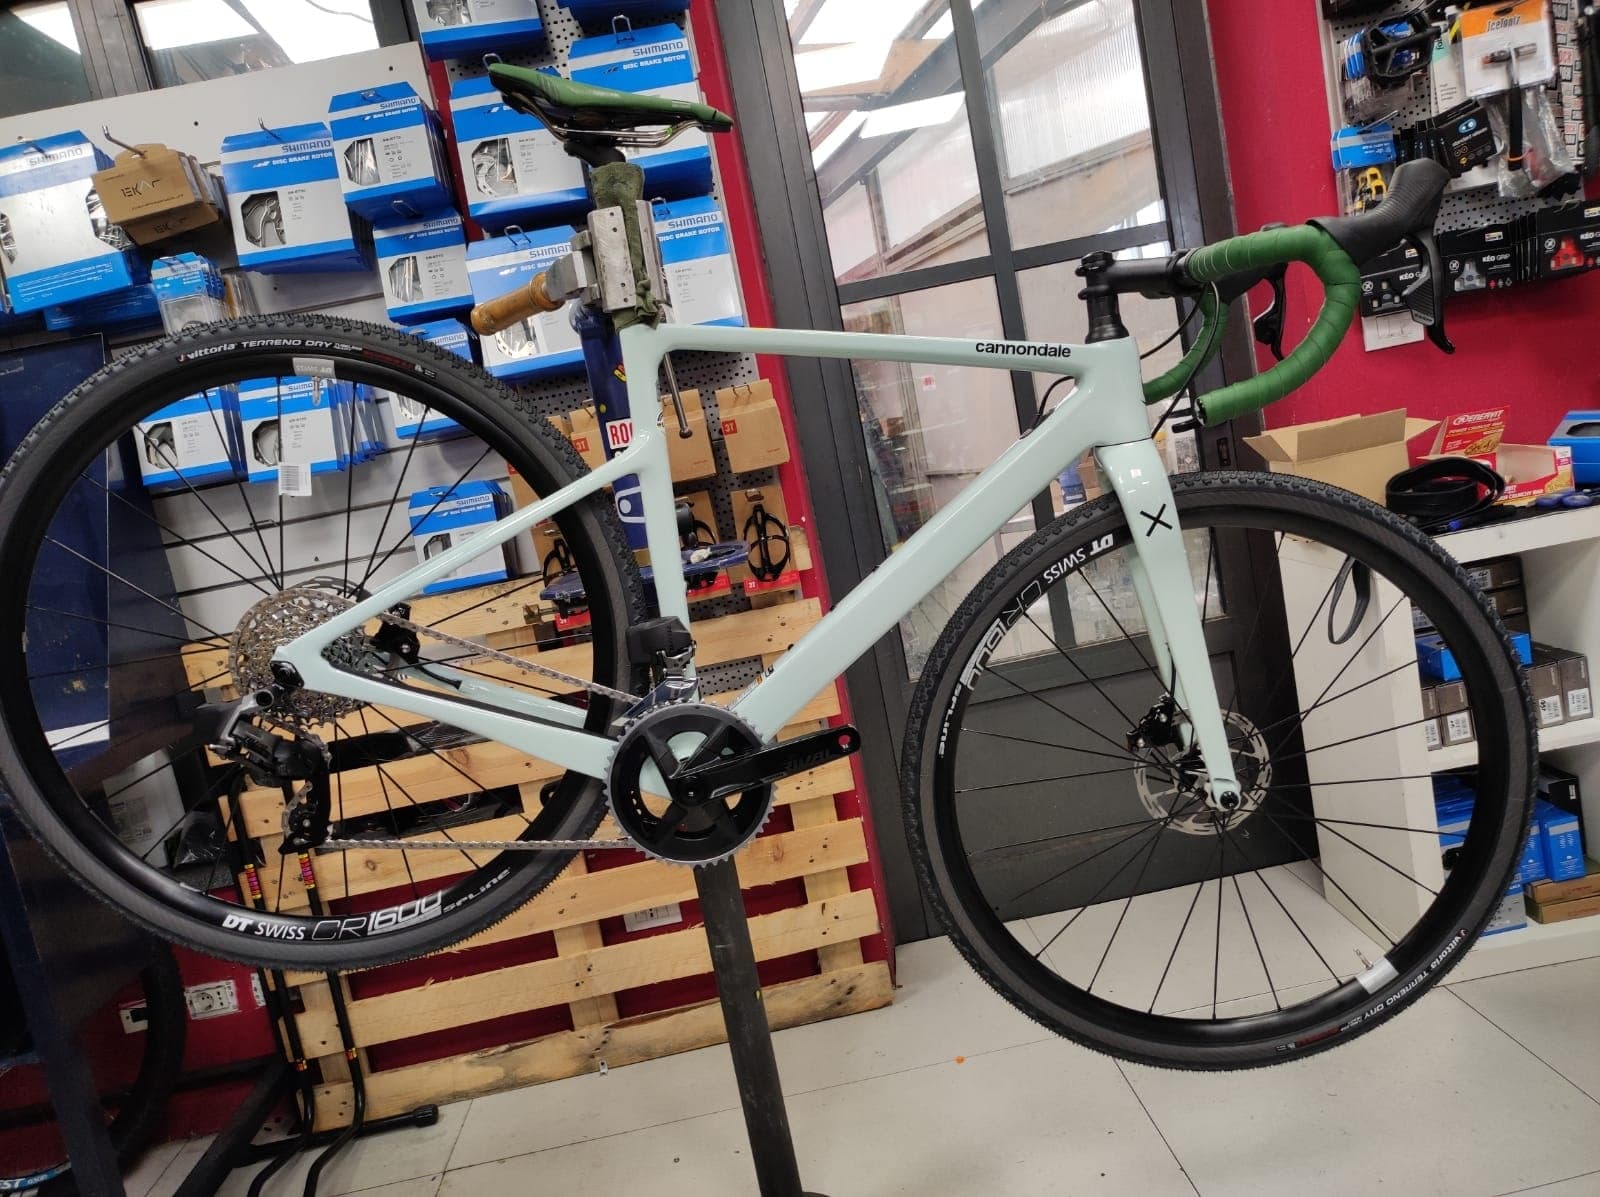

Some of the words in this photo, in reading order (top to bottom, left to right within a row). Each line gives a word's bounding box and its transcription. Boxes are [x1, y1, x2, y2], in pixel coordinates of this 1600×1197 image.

[633, 41, 684, 57] SHIMANO
[640, 59, 662, 68] BRAKE
[664, 54, 686, 64] ROTOR
[380, 97, 416, 110] SHIMANO
[281, 140, 332, 153] SHIMANO
[29, 147, 83, 166] SHIMANO
[272, 158, 288, 166] DISC
[289, 155, 310, 163] BRAKE
[311, 152, 333, 160] ROTOR
[423, 217, 458, 230] SHIMANO
[668, 213, 718, 229] SHIMANO
[675, 230, 697, 239] BRAKE
[698, 226, 720, 234] ROTOR
[529, 241, 573, 259] SHIMAN
[433, 333, 465, 345] HIMANO
[187, 342, 238, 359] vittoria
[241, 339, 302, 348] TERRENO
[304, 340, 333, 349] DRY
[976, 342, 1071, 358] cannondale
[724, 423, 735, 433] 3T
[576, 441, 586, 450] 3T
[456, 496, 490, 506] SHIMANO
[1090, 533, 1114, 556] DT
[1043, 547, 1087, 584] SWISS
[222, 914, 253, 931] DT
[254, 922, 306, 940] SWISS
[1430, 936, 1466, 970] vittoria
[1385, 969, 1429, 1006] TERRENO
[1363, 1004, 1385, 1019] DRY
